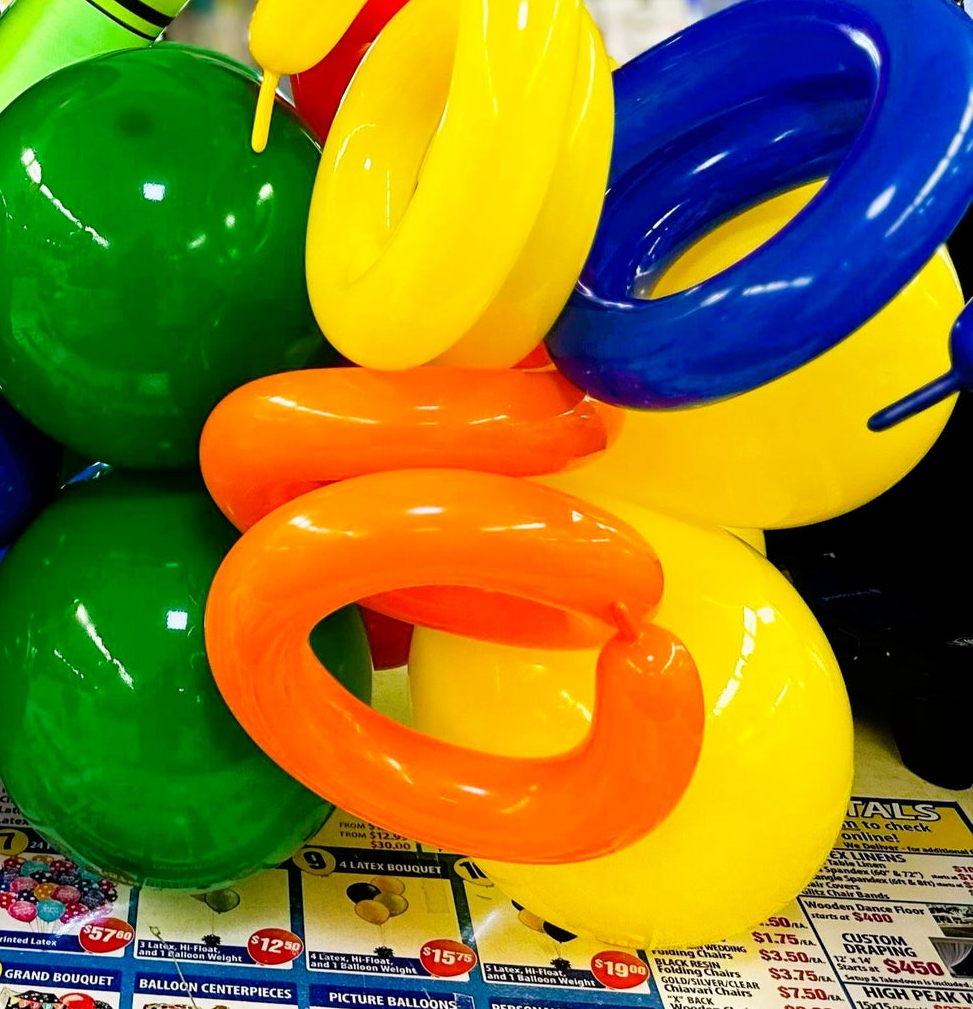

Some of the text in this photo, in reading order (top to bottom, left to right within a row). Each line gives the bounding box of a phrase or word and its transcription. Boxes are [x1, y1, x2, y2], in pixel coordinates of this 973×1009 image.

[862, 821, 931, 832] to check
[841, 832, 899, 843] online!
[370, 840, 411, 850] $30.00
[863, 843, 898, 851] Deliver
[306, 852, 327, 870] 9
[852, 853, 906, 863] LINENS
[350, 861, 384, 871] LATEX
[387, 863, 441, 874] BOUQUET
[825, 866, 869, 876] Spandex
[844, 875, 887, 884] Spandex
[827, 882, 861, 891] Covers
[857, 892, 890, 900] Bands
[804, 901, 925, 915] Wooden Dance Floor
[852, 912, 893, 923] $400
[30, 937, 57, 947] Latex
[842, 933, 908, 946] CUSTOM
[179, 944, 221, 954] Hi-Float,
[697, 949, 733, 959] Chairs
[705, 944, 747, 953] WEDDING
[843, 943, 917, 958] DRAPING
[138, 948, 243, 962] and Balloon Weight
[310, 953, 394, 966] 4 Latex, Hi-Float,
[310, 960, 417, 975] and Balloon Weight
[655, 958, 720, 969] BLACK RESIN
[837, 964, 867, 972] Starts
[883, 958, 944, 976] $450
[492, 966, 521, 975] Latex,
[524, 968, 566, 977] Hi-Float,
[657, 966, 741, 978] Folding Chairs
[4, 969, 114, 986] GRAND BOUQUET
[487, 973, 596, 987] and Balloon Weight
[879, 977, 923, 985] Takedown
[139, 978, 293, 999] BALLOON CENTERPIECES
[664, 984, 753, 998] Chiavari Chairs
[329, 992, 457, 1009] PICTURE BALLOONS
[863, 987, 960, 1003] HIGH PEAK
[687, 996, 714, 1006] BACK
